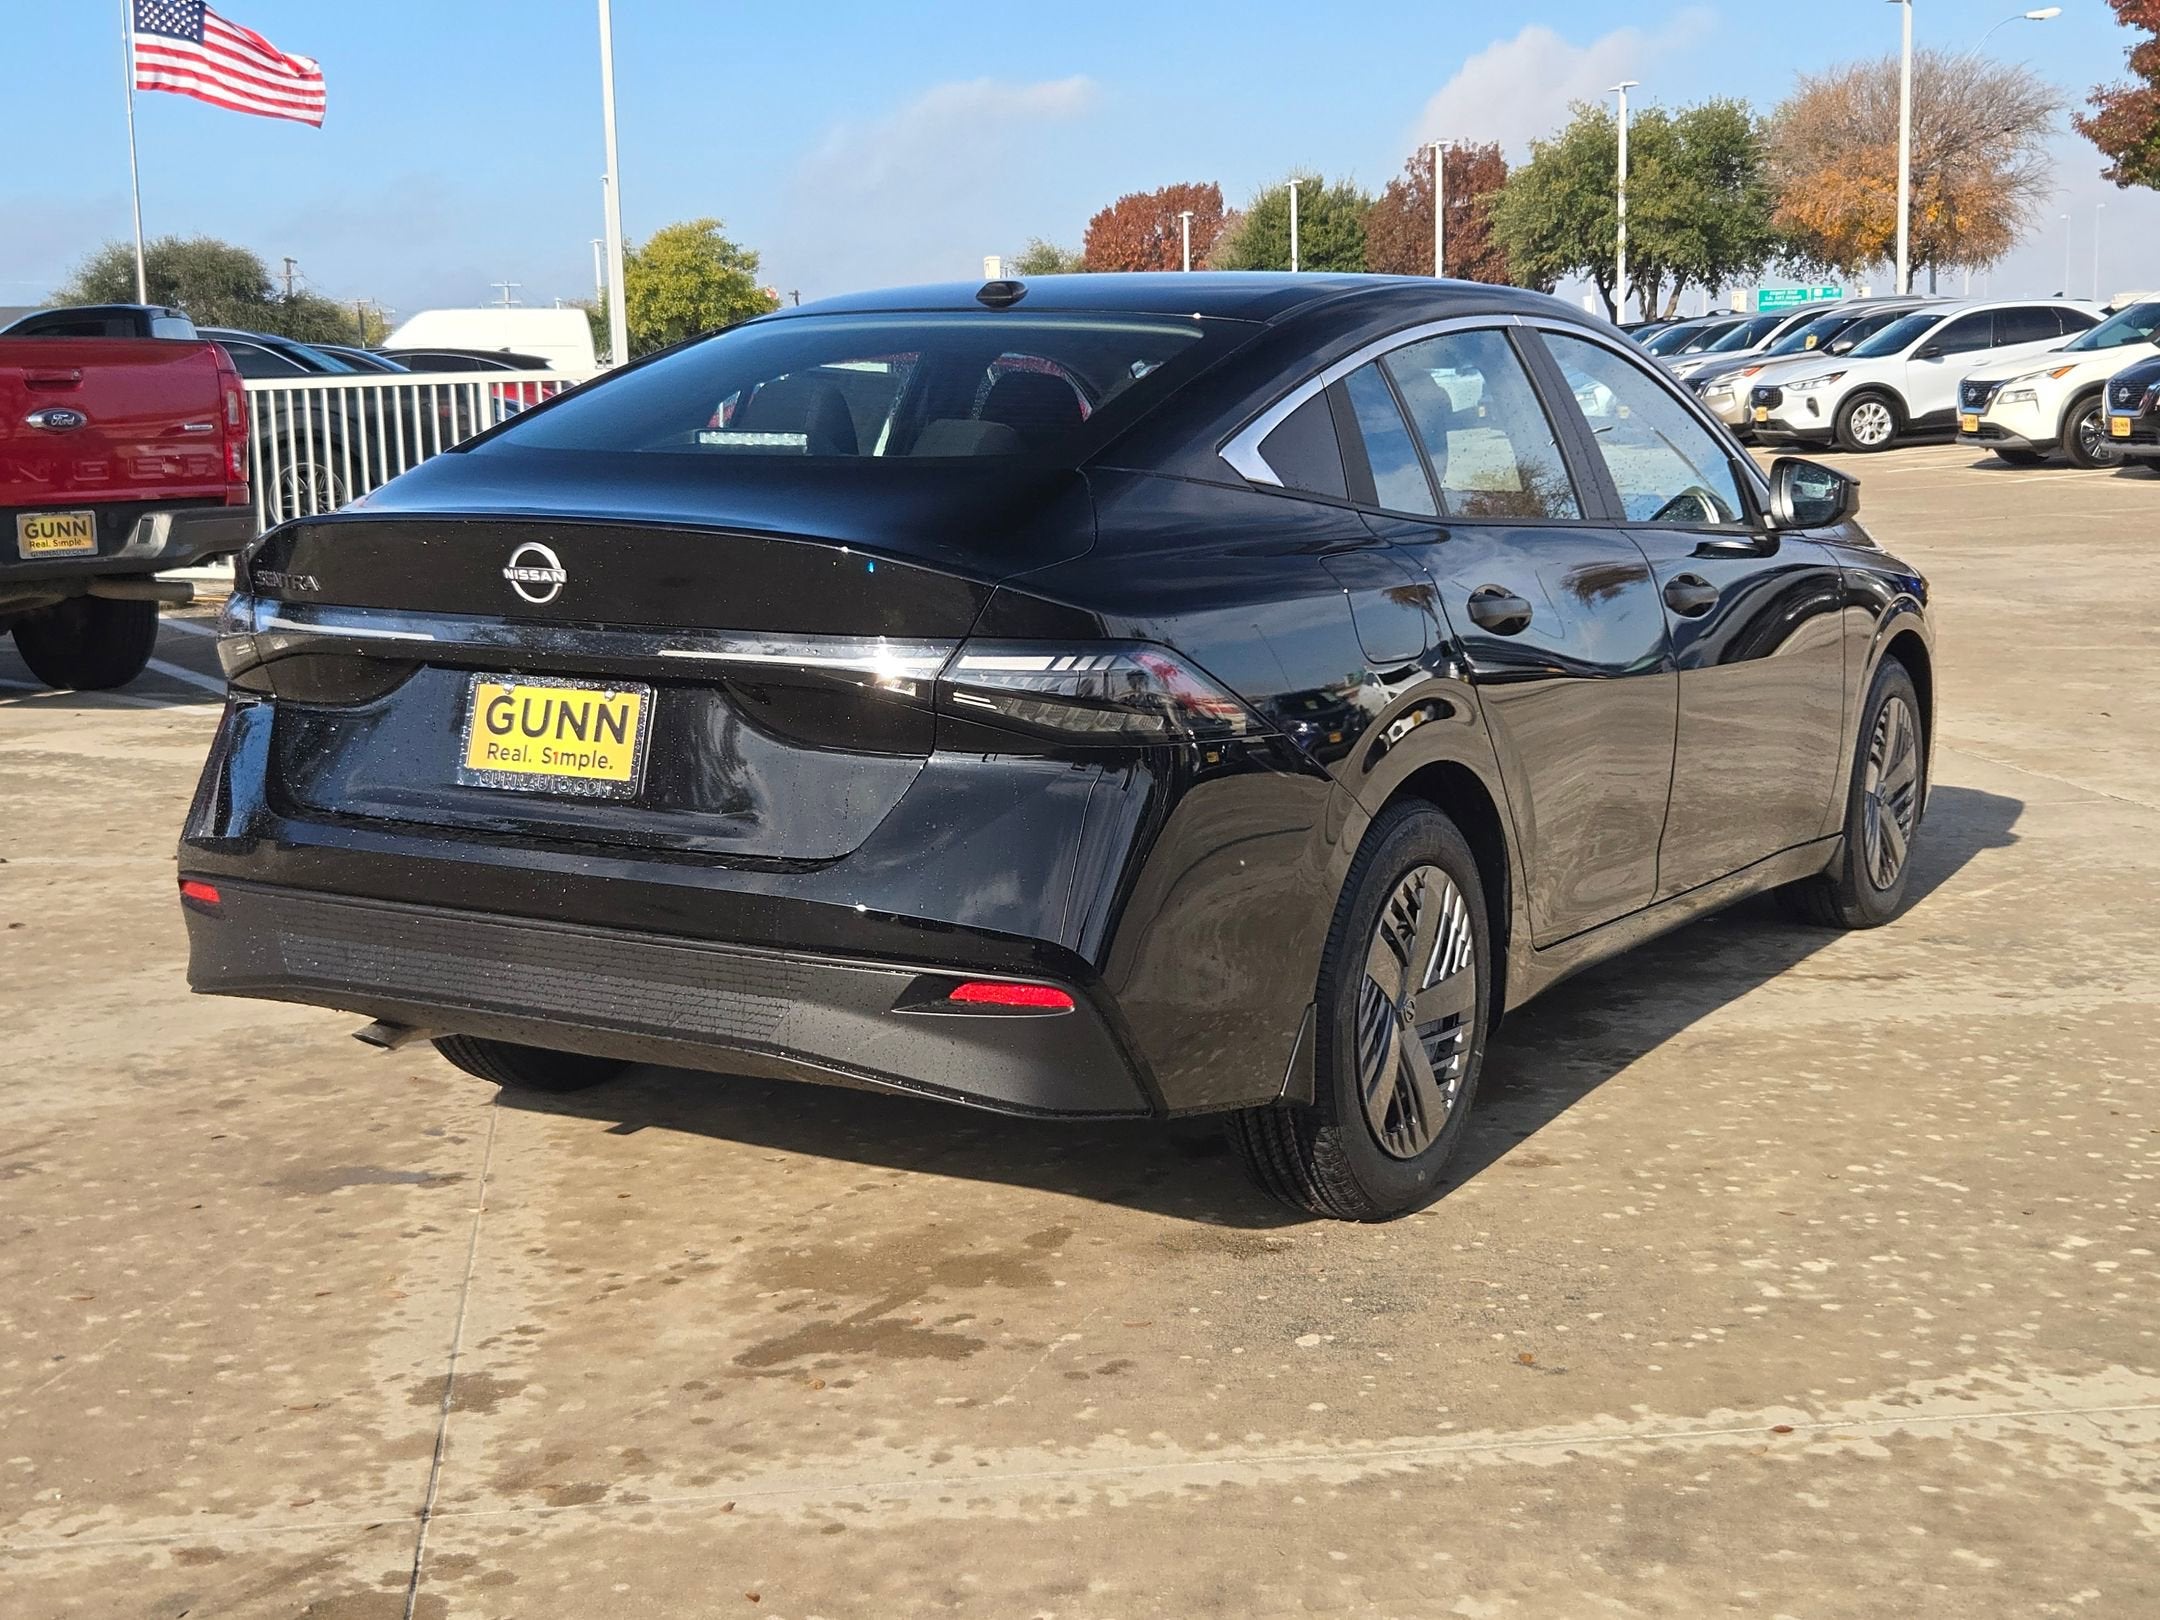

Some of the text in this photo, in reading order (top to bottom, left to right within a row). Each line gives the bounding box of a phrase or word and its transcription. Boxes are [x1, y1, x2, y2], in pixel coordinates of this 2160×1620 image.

[51, 414, 75, 426] Ford
[24, 520, 87, 539] GUNN
[29, 540, 52, 548] Real.
[503, 568, 567, 583] NISSAN
[486, 695, 629, 744] GUNN
[487, 742, 532, 763] Real.
